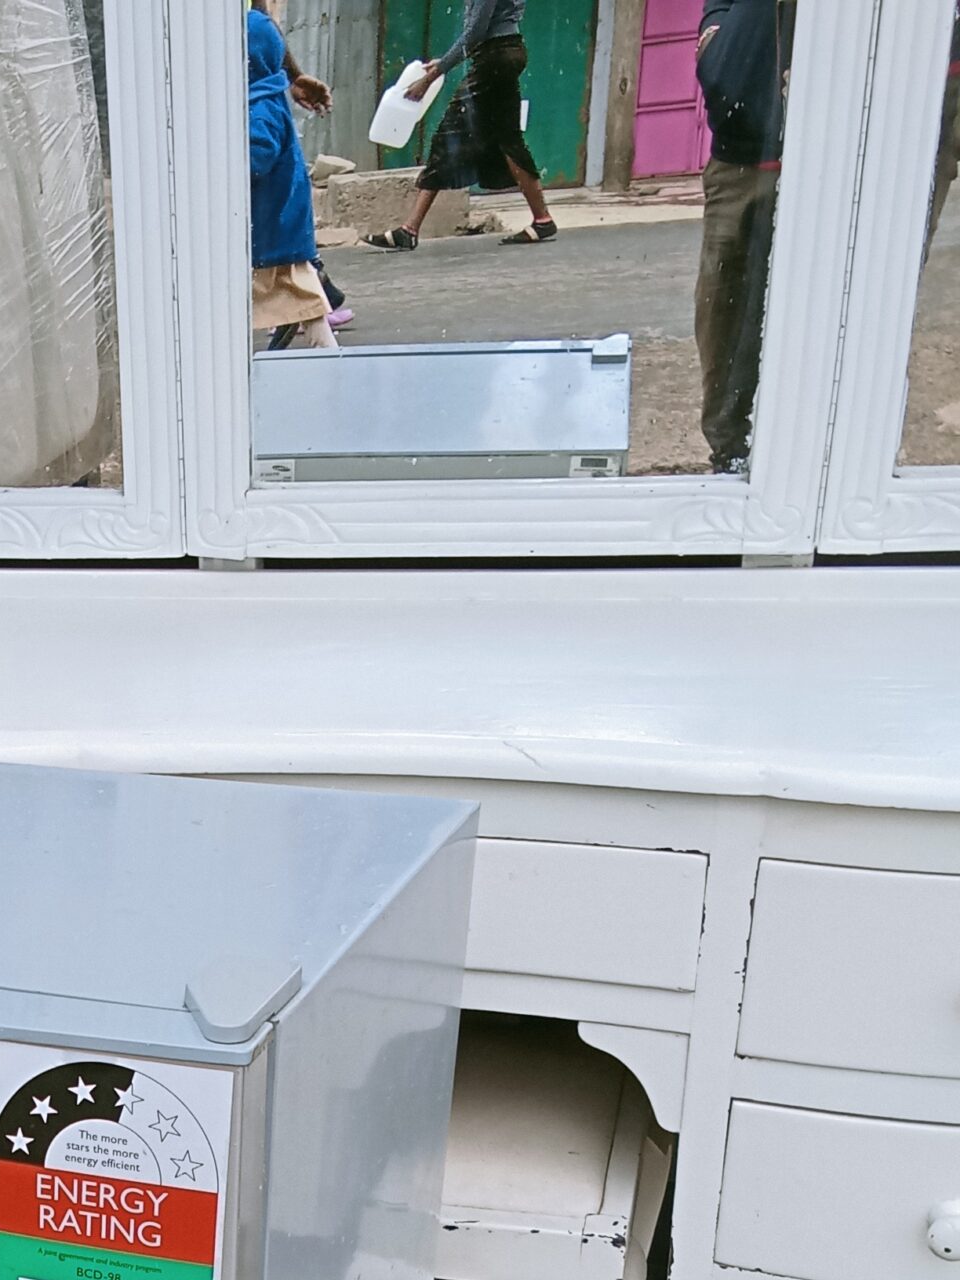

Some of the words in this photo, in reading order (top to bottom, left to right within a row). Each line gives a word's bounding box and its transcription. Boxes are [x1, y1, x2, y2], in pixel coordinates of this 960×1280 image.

[79, 1129, 98, 1142] The
[101, 1135, 128, 1146] more
[66, 1142, 90, 1153] stars
[93, 1144, 109, 1155] the
[112, 1149, 140, 1160] more
[65, 1154, 99, 1168] energy
[101, 1158, 141, 1173] efficient
[36, 1172, 169, 1217] ENERGY
[39, 1204, 162, 1248] RATING
[96, 1257, 108, 1265] and
[109, 1259, 135, 1270] industry
